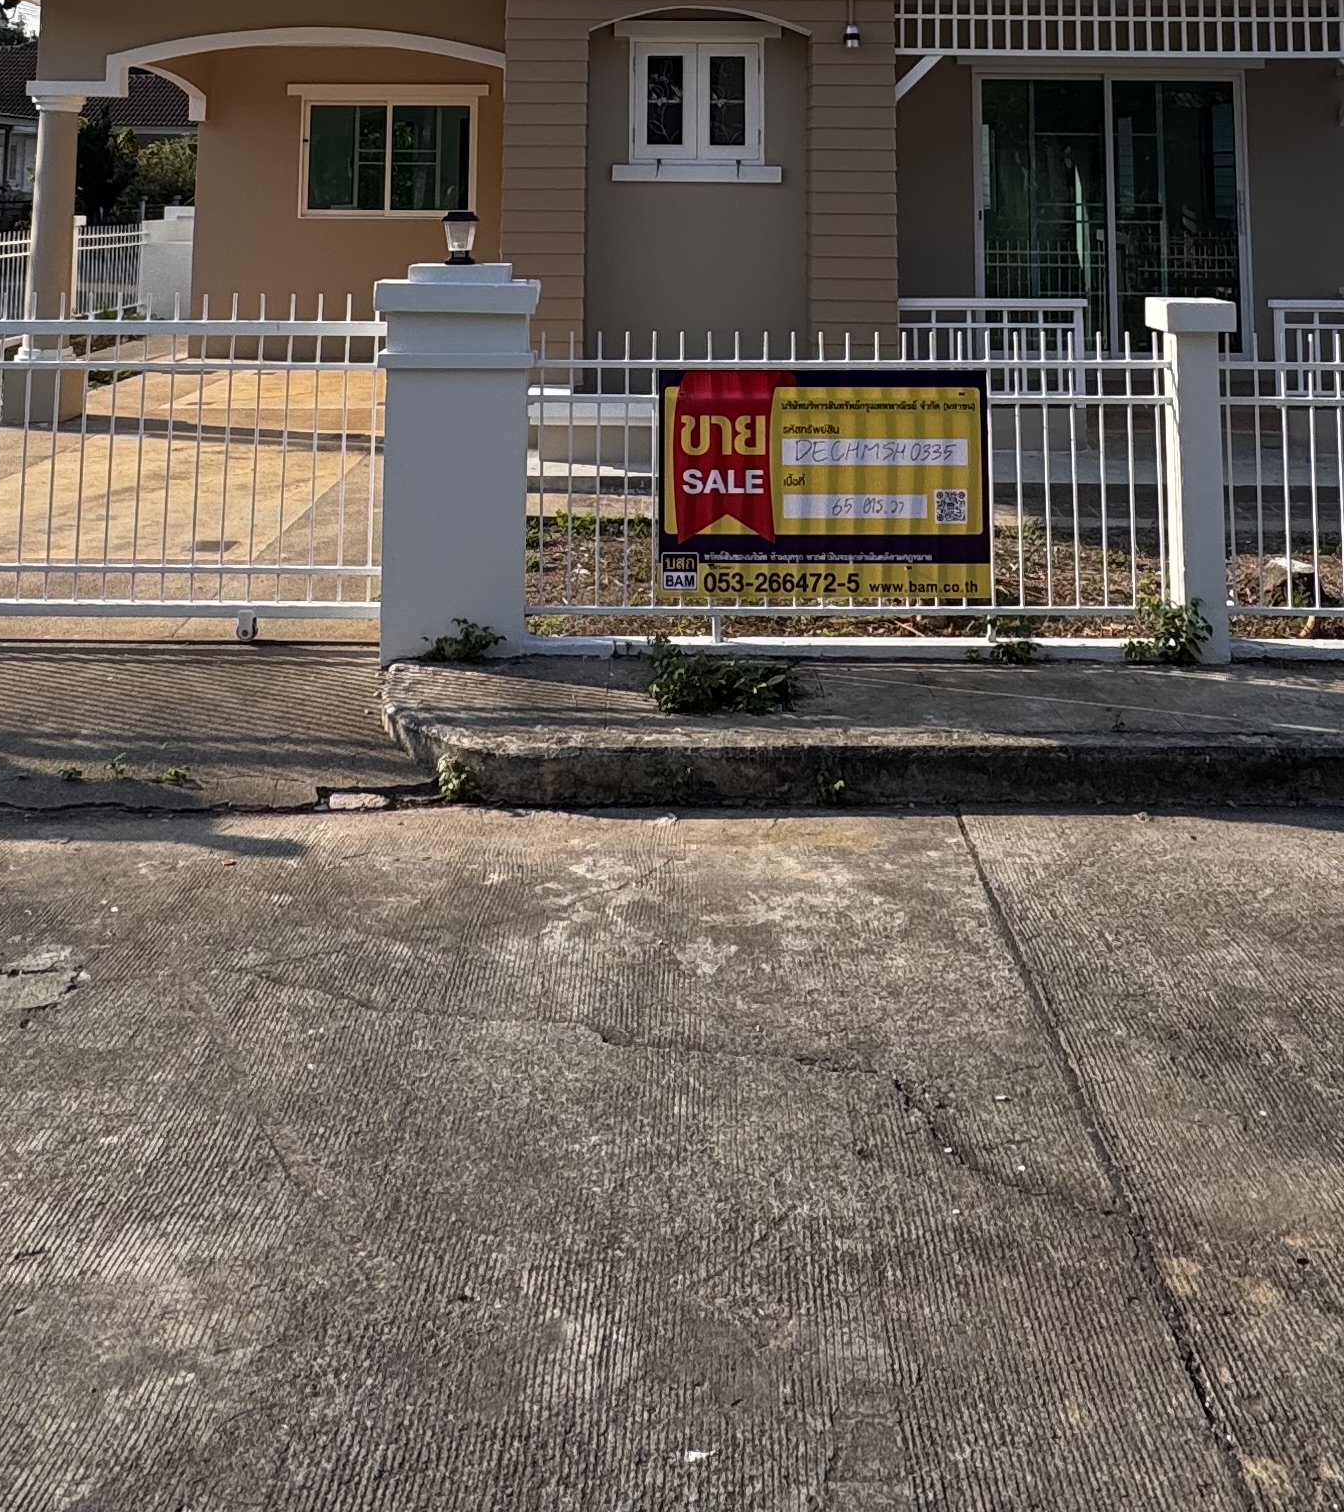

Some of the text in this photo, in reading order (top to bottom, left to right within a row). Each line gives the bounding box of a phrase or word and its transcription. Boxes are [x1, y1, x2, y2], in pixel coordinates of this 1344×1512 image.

[680, 414, 766, 456] ขาย
[682, 468, 765, 495] SALE
[831, 497, 854, 516] 65
[664, 557, 695, 570] บสก
[665, 575, 695, 587] BAM
[703, 572, 978, 594] 053-266472-5 www.bam.co.th
